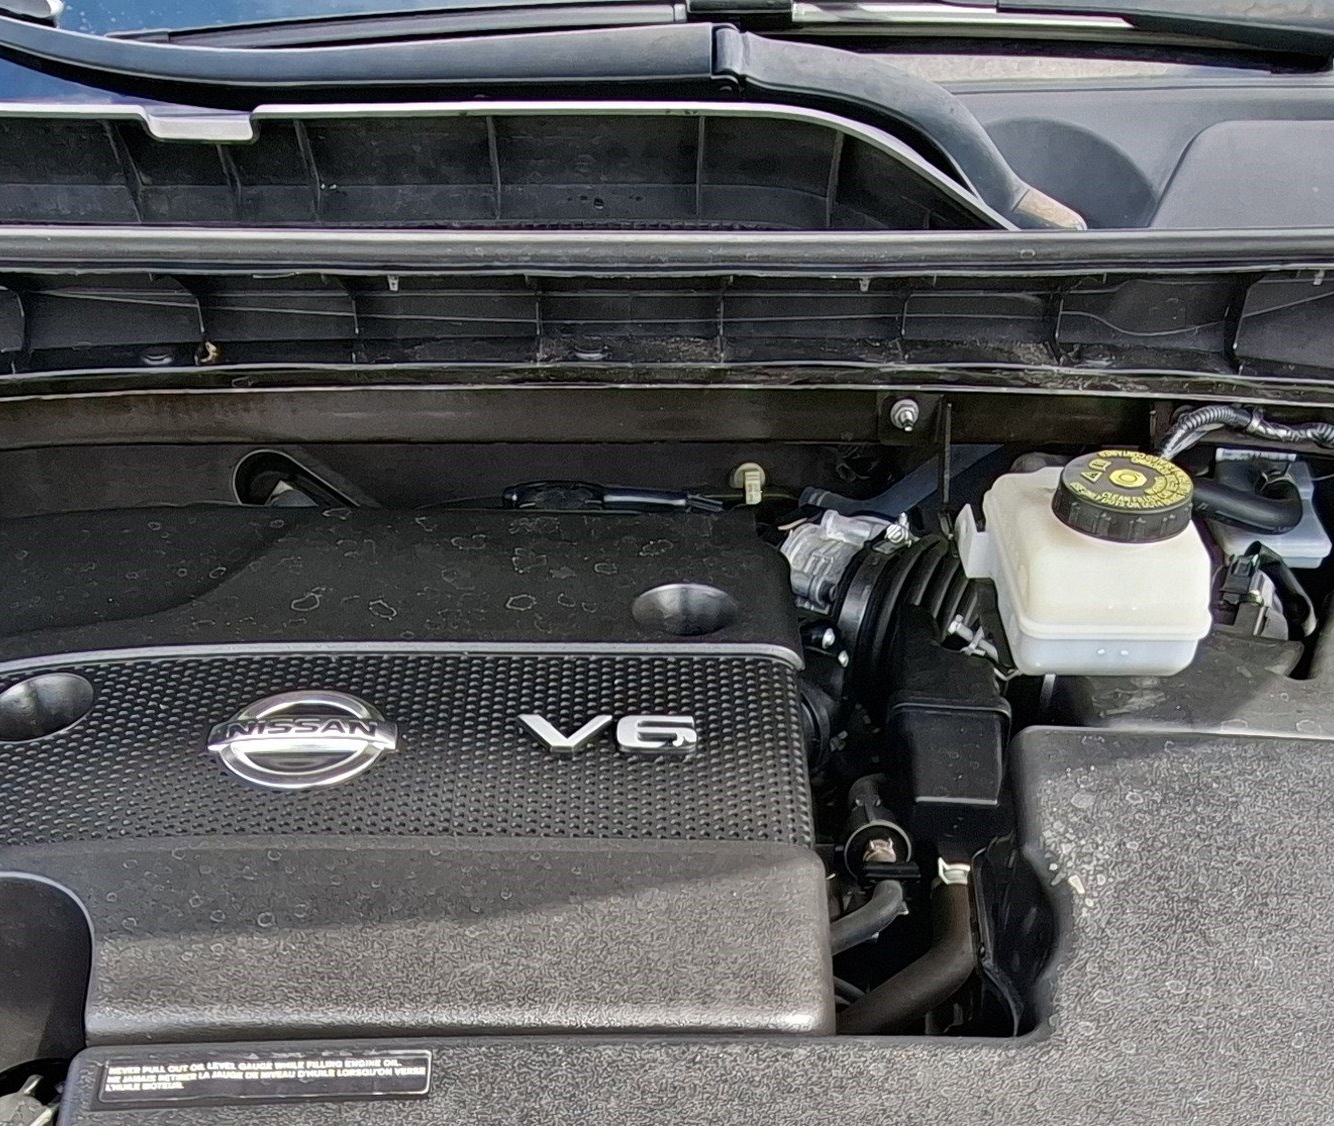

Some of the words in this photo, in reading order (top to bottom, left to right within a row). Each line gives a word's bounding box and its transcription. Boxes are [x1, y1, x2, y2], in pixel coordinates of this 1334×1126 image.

[228, 718, 378, 738] NISSAN
[516, 713, 698, 755] V6
[142, 1066, 166, 1074] PULL
[167, 1065, 189, 1073] OUT
[207, 1062, 236, 1071] LEVEL
[238, 1062, 272, 1070] GAUGE
[275, 1061, 304, 1069] WHILE
[306, 1060, 343, 1069] FILLING
[345, 1059, 382, 1068] ENGINE
[199, 1072, 210, 1080] LA
